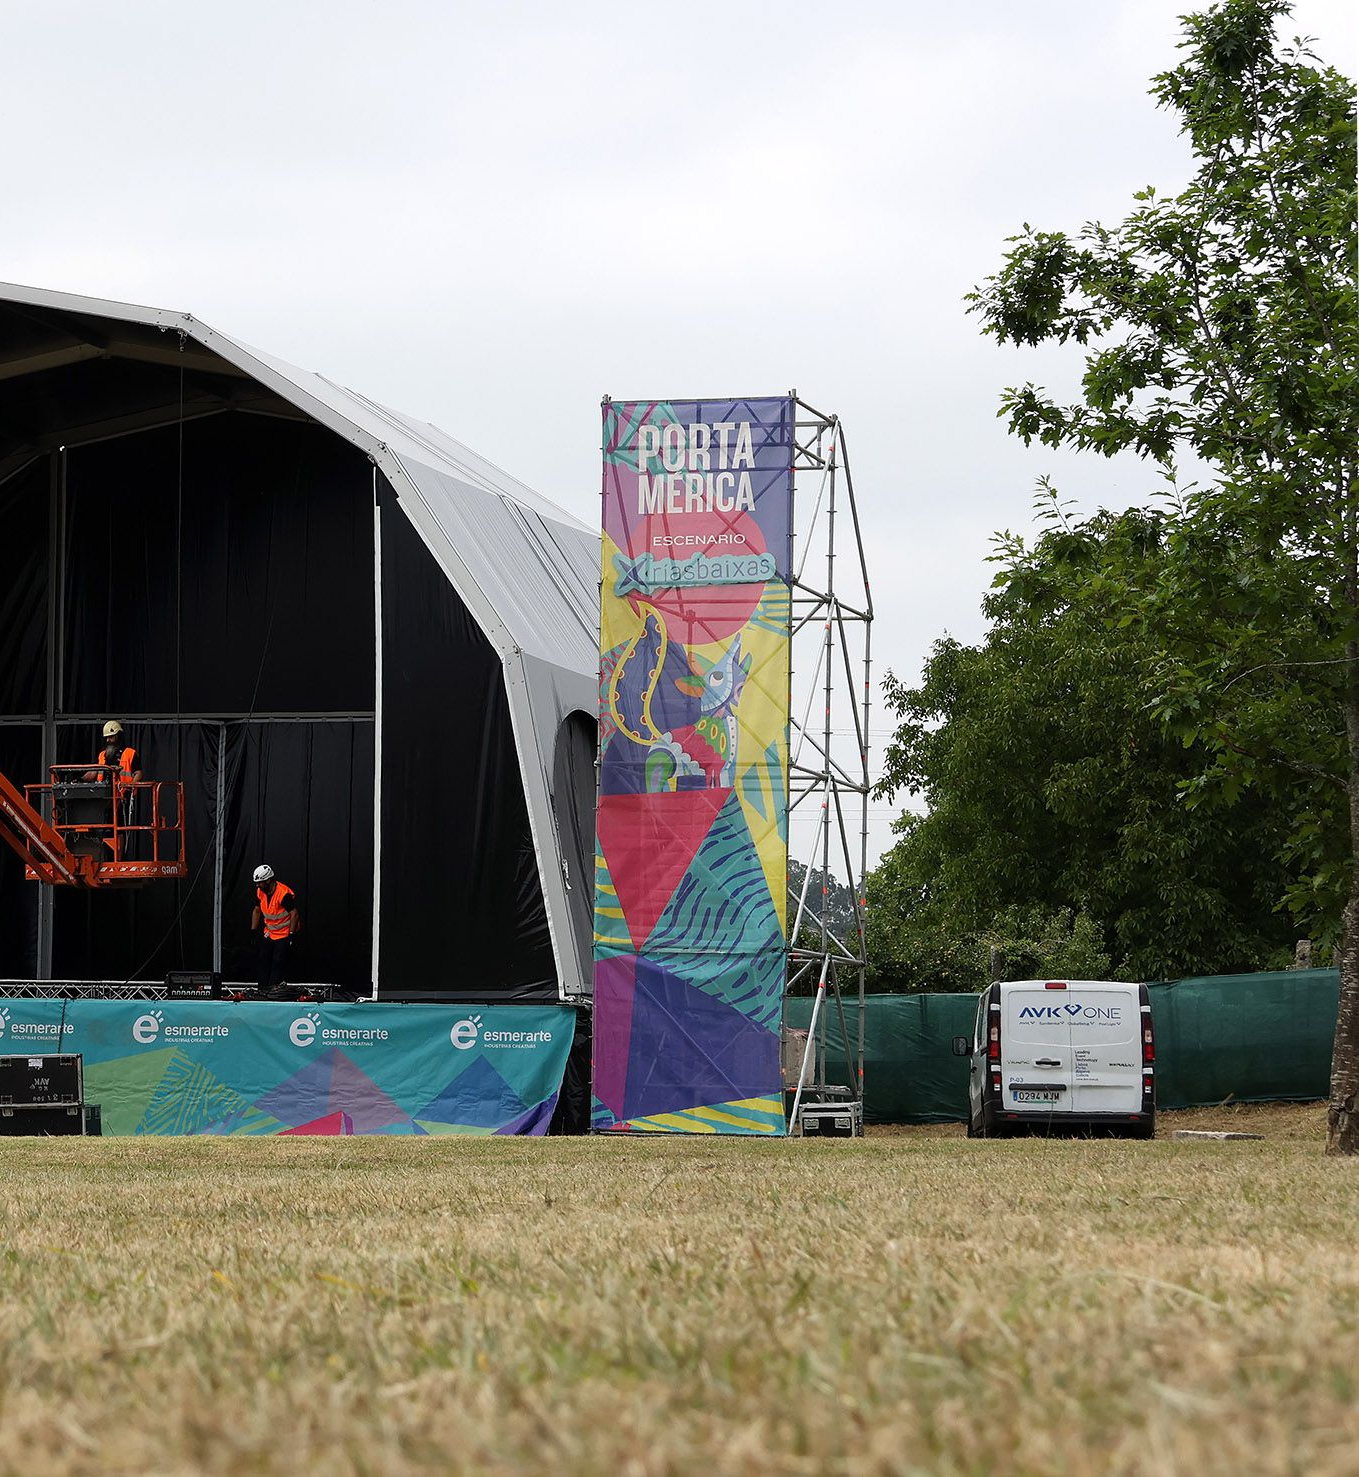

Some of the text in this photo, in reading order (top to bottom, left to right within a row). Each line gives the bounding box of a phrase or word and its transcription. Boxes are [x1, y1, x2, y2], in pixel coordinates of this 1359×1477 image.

[638, 422, 755, 473] PORTA
[638, 471, 755, 514] MÉRICA
[653, 534, 746, 546] ESCENARIO
[1019, 1007, 1121, 1019] AVK ONE
[11, 1022, 74, 1034] esmerarte
[165, 1025, 229, 1037] esmerarte
[322, 1027, 388, 1040] esmerarte
[483, 1030, 552, 1042] esmerarte
[1019, 1092, 1040, 1100] 0294
